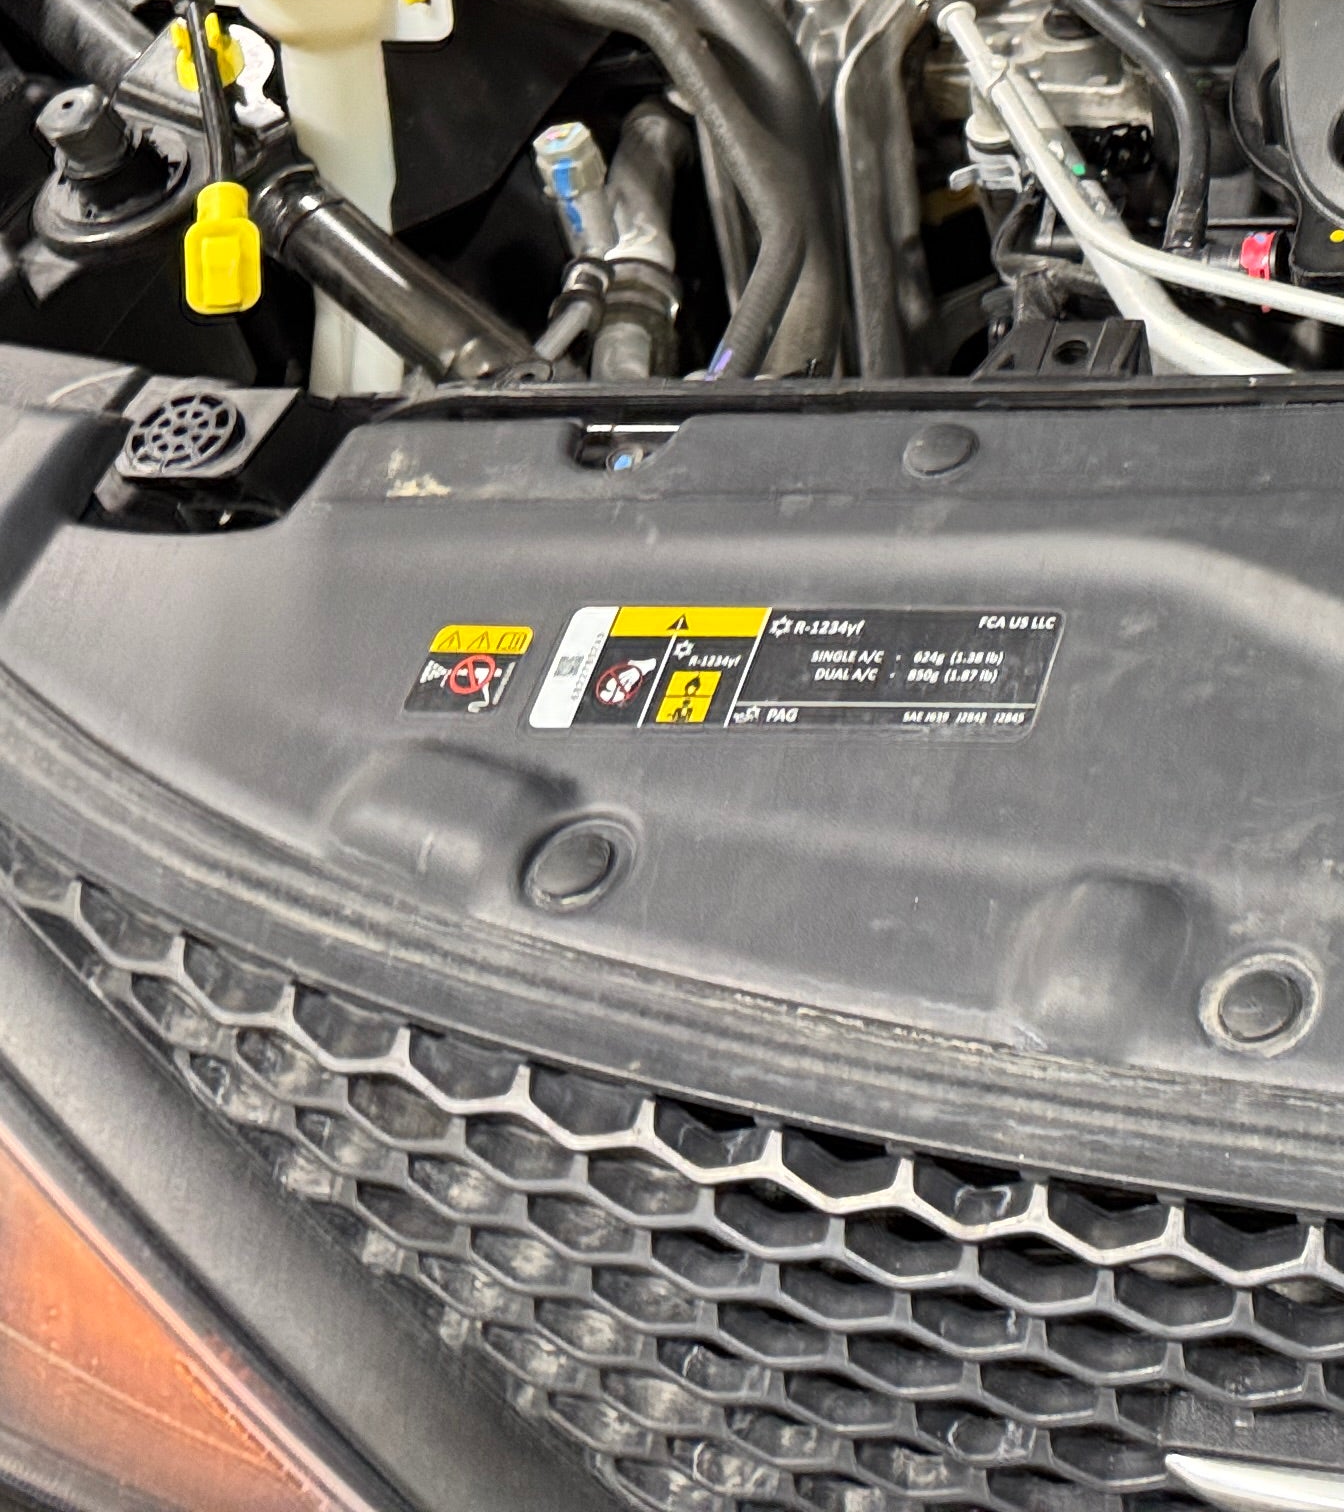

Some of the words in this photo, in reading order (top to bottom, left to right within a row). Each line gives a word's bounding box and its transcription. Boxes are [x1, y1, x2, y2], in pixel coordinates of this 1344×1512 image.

[978, 616, 1006, 629] FCA
[1009, 616, 1029, 630] US
[1031, 617, 1057, 630] LLC
[810, 650, 855, 663] SINGLE
[857, 650, 885, 663] A/C
[813, 667, 850, 681] DUAL
[851, 667, 878, 681] A/C
[766, 709, 799, 723] PAG
